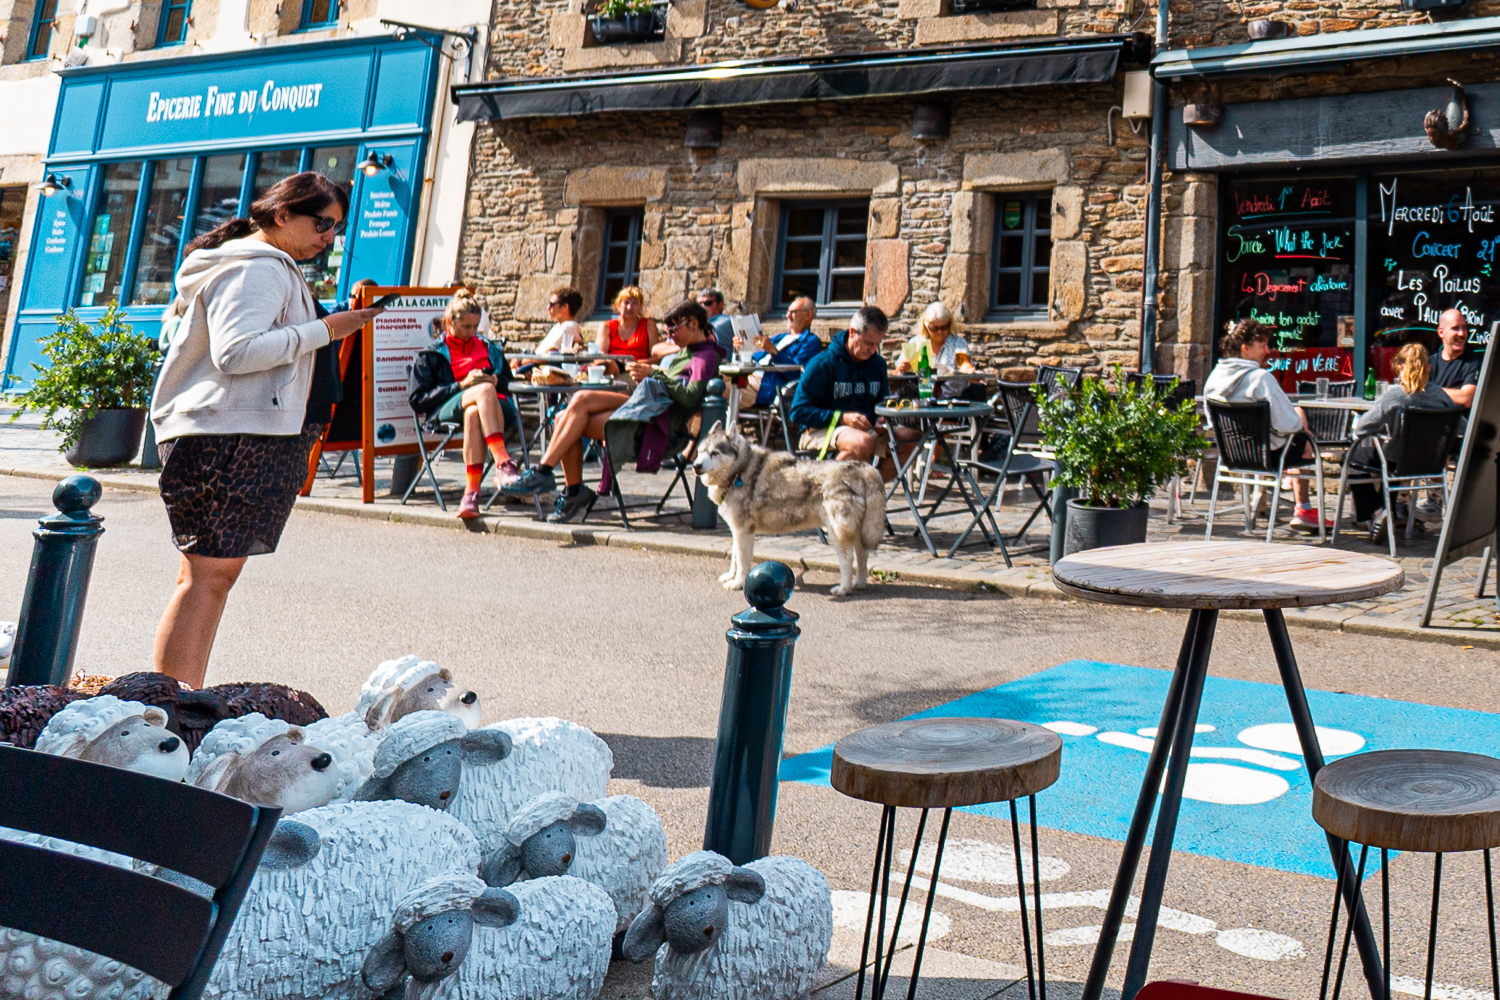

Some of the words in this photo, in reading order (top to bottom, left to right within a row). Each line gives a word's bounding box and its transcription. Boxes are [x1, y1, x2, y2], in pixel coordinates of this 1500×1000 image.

[146, 91, 202, 122] EPICERIE
[204, 85, 236, 117] FINE
[261, 79, 323, 113] CONQUET
[1447, 194, 1460, 223] 6
[405, 298, 418, 308] LA
